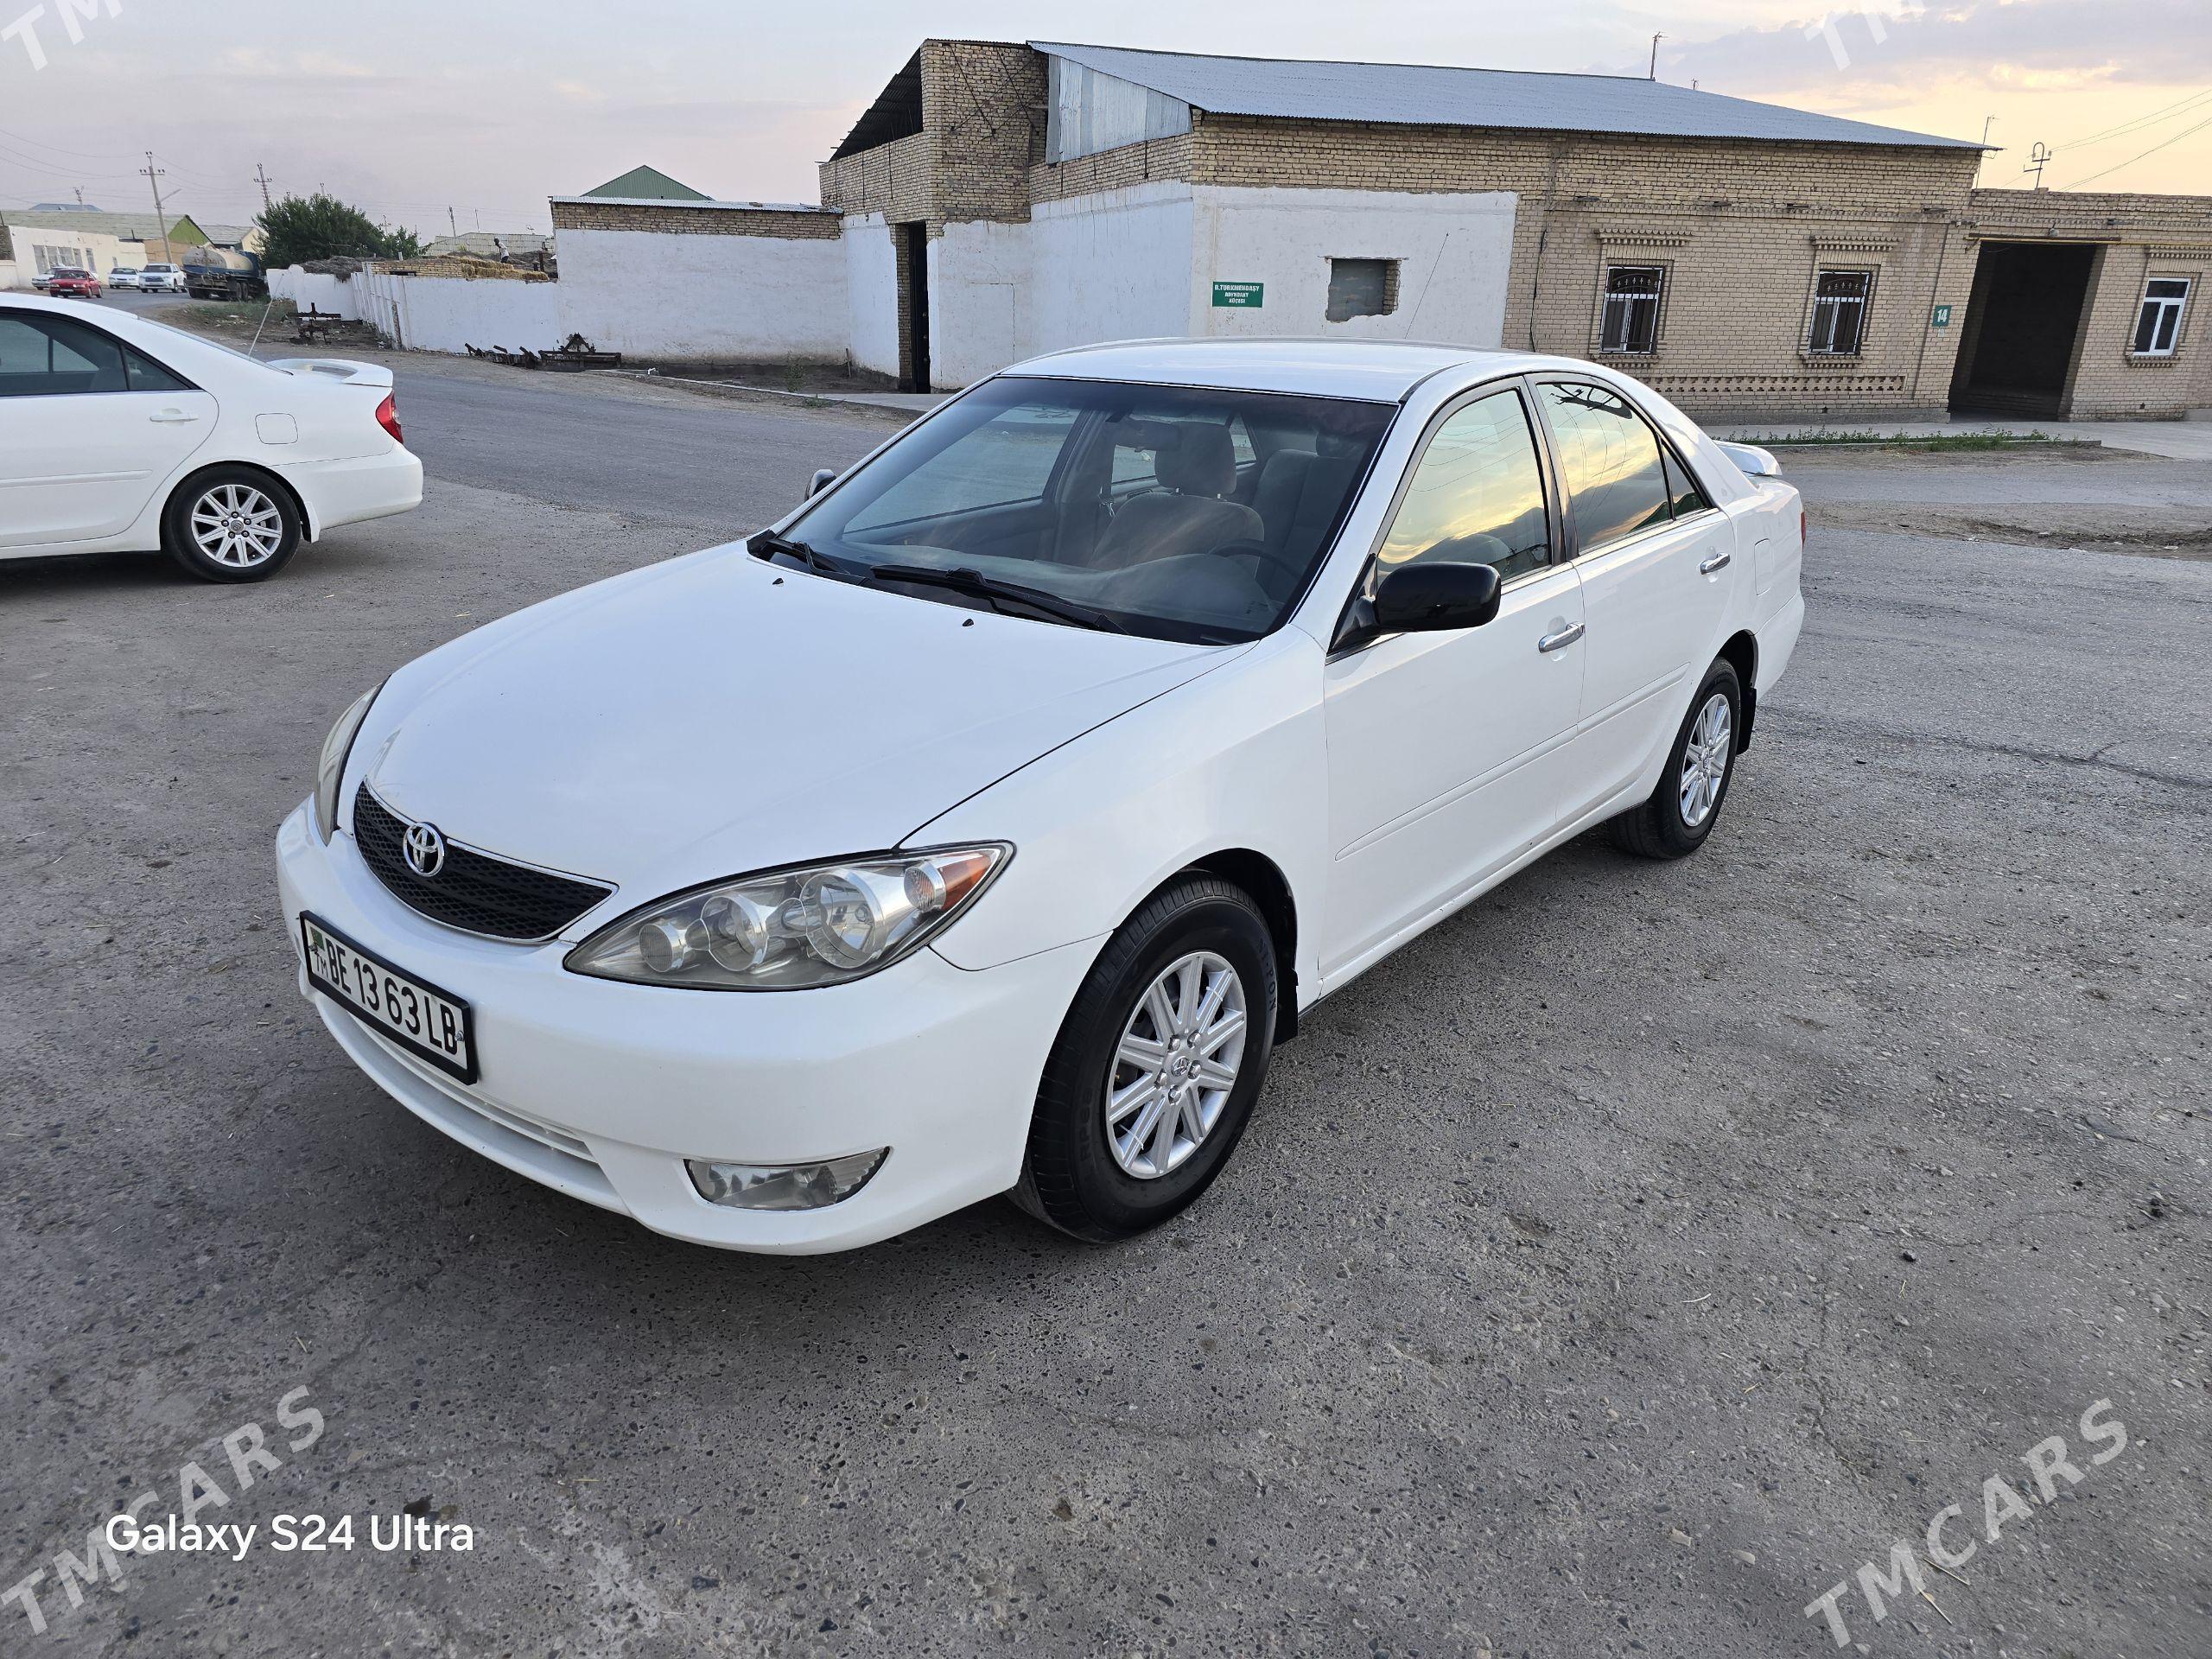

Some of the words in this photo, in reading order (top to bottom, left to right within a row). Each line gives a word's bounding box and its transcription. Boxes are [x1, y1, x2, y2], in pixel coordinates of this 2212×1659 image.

[1937, 308, 1948, 322] 14
[325, 938, 352, 995] BE
[424, 995, 458, 1055] LB
